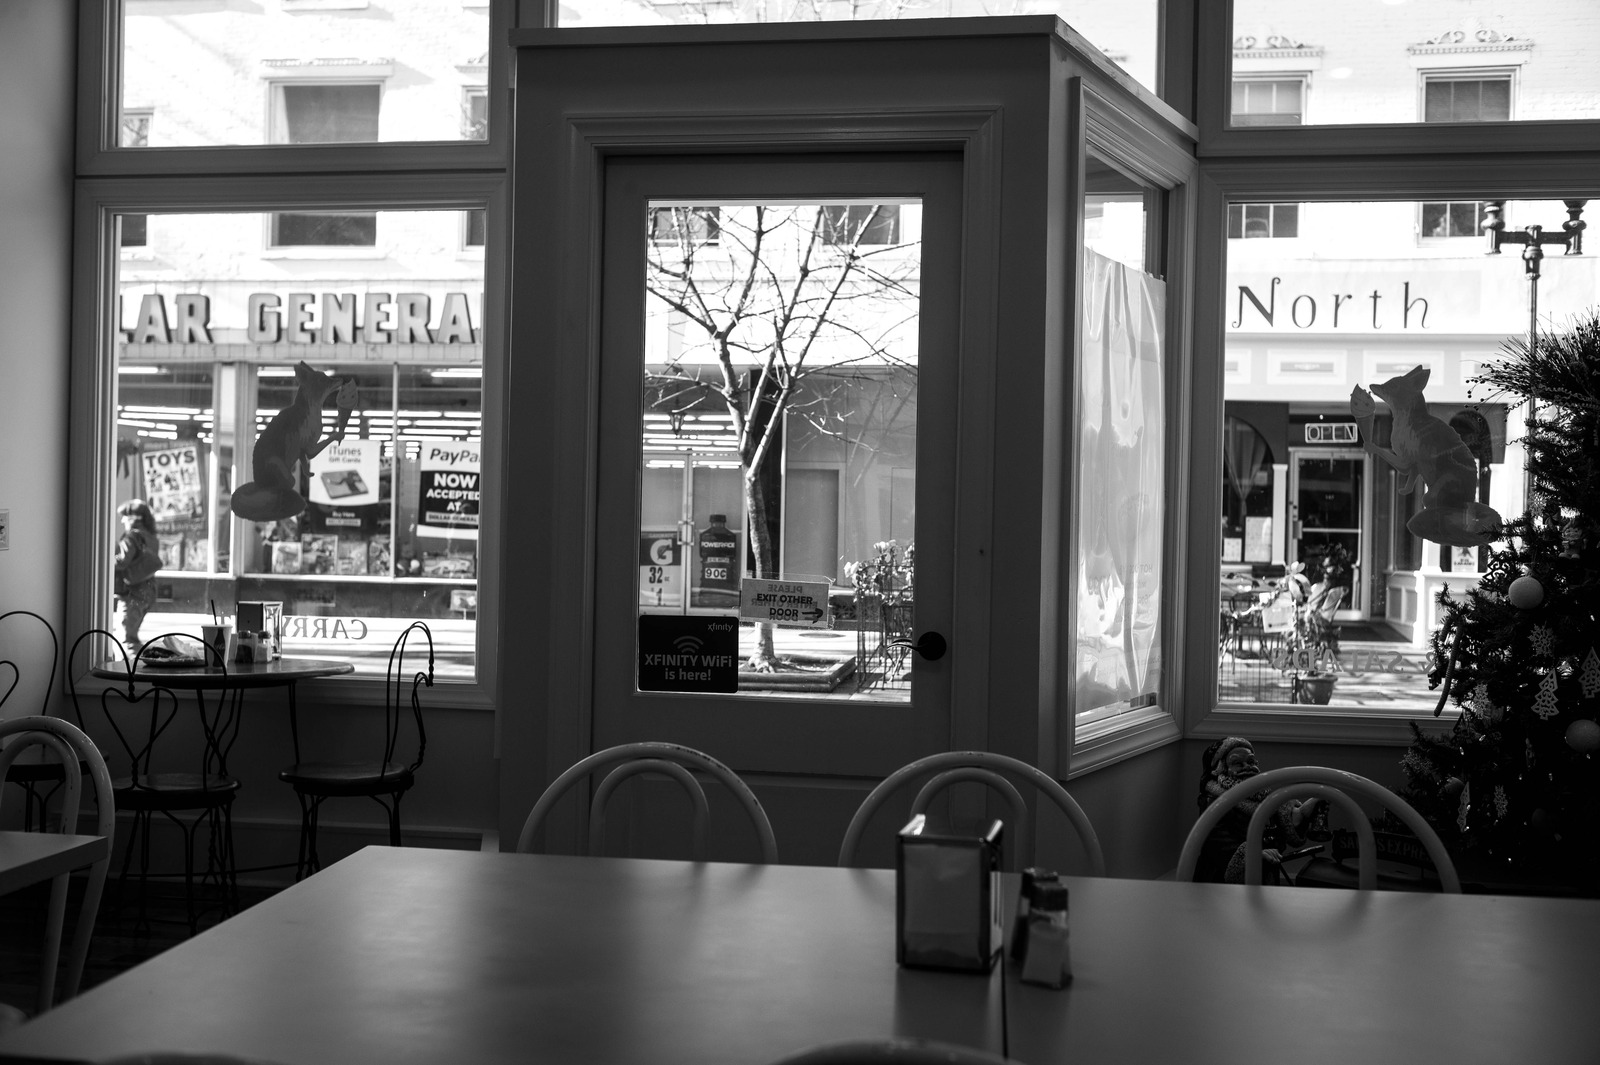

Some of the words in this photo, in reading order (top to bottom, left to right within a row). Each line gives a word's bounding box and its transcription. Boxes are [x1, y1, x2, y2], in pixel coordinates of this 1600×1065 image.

[1232, 276, 1430, 329] North
[248, 293, 483, 344] GENERA
[1307, 424, 1356, 441] OPEN
[145, 450, 195, 468] TOYS
[429, 448, 480, 465] PayPa
[433, 472, 477, 489] NOW
[446, 501, 462, 512] AT
[648, 566, 663, 584] 32
[756, 593, 777, 603] EXIT
[779, 594, 813, 605] OTHER
[769, 608, 799, 618] DOOR
[707, 622, 734, 632] xfinity
[644, 653, 698, 667] XFINITY
[701, 655, 732, 668] WiFi
[664, 667, 676, 680] is
[678, 668, 712, 681] here!
